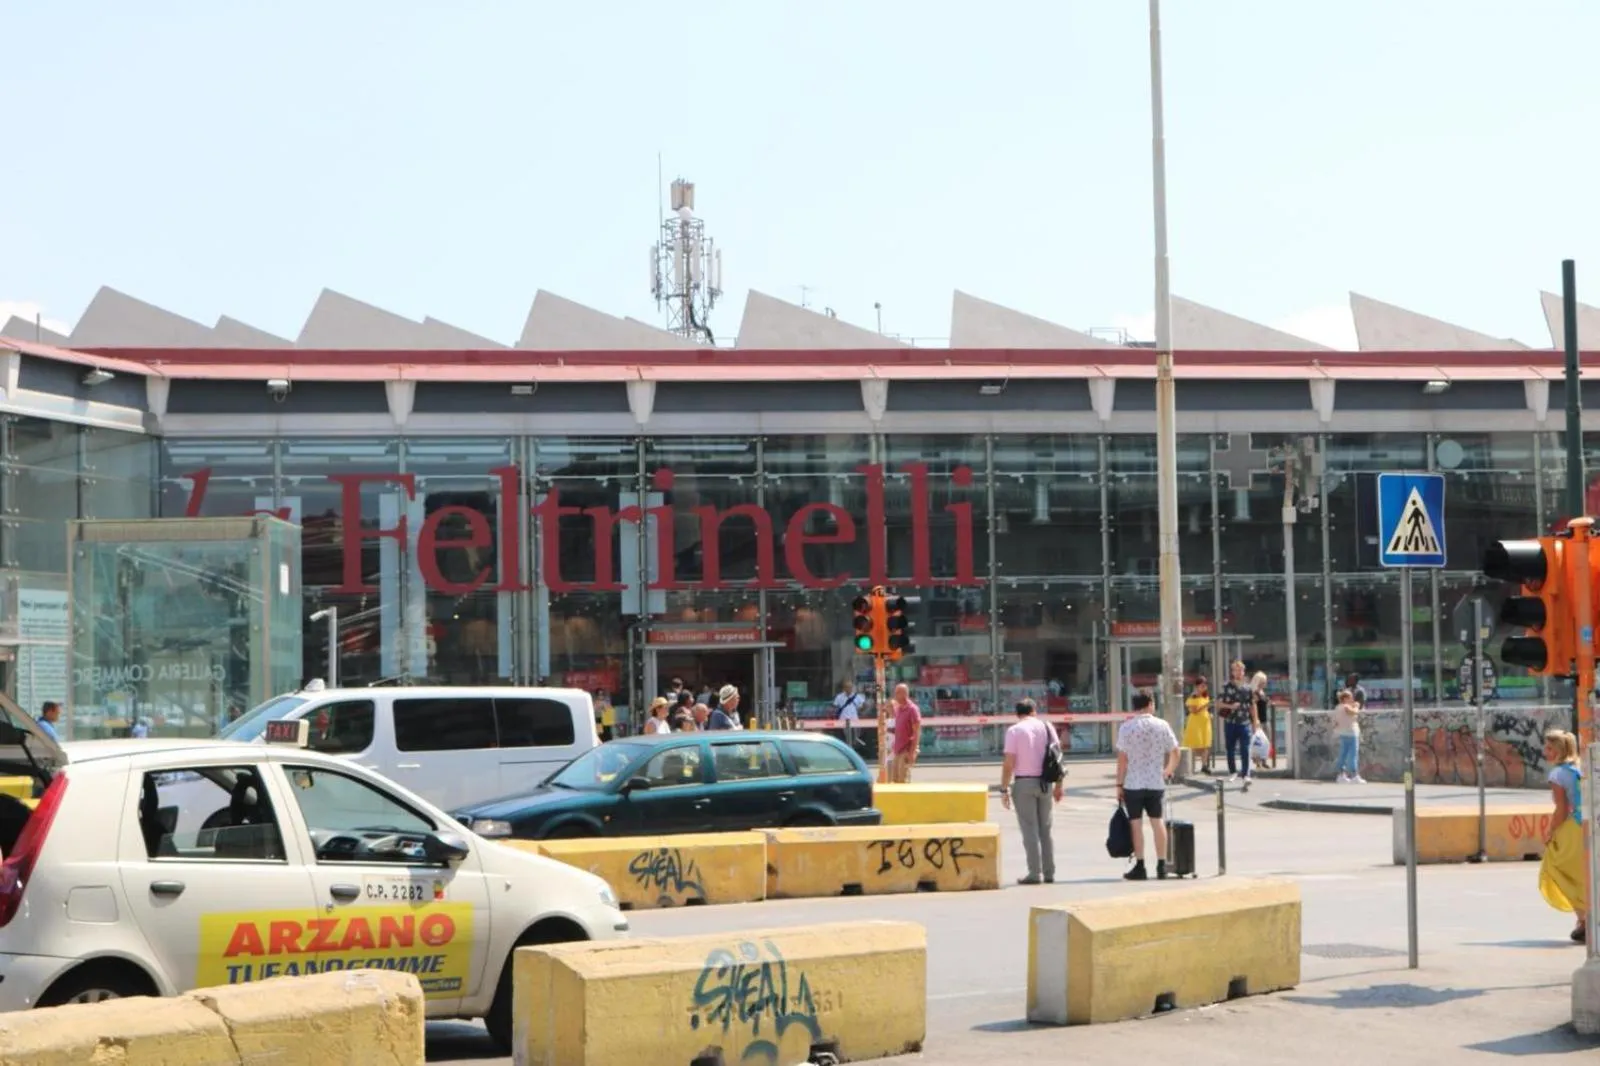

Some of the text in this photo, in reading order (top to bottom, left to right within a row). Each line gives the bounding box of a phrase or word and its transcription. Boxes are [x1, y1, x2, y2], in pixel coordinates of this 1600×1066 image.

[328, 464, 986, 592] Feltrinelli
[392, 885, 424, 901] 2282
[223, 911, 456, 957] ARZANO
